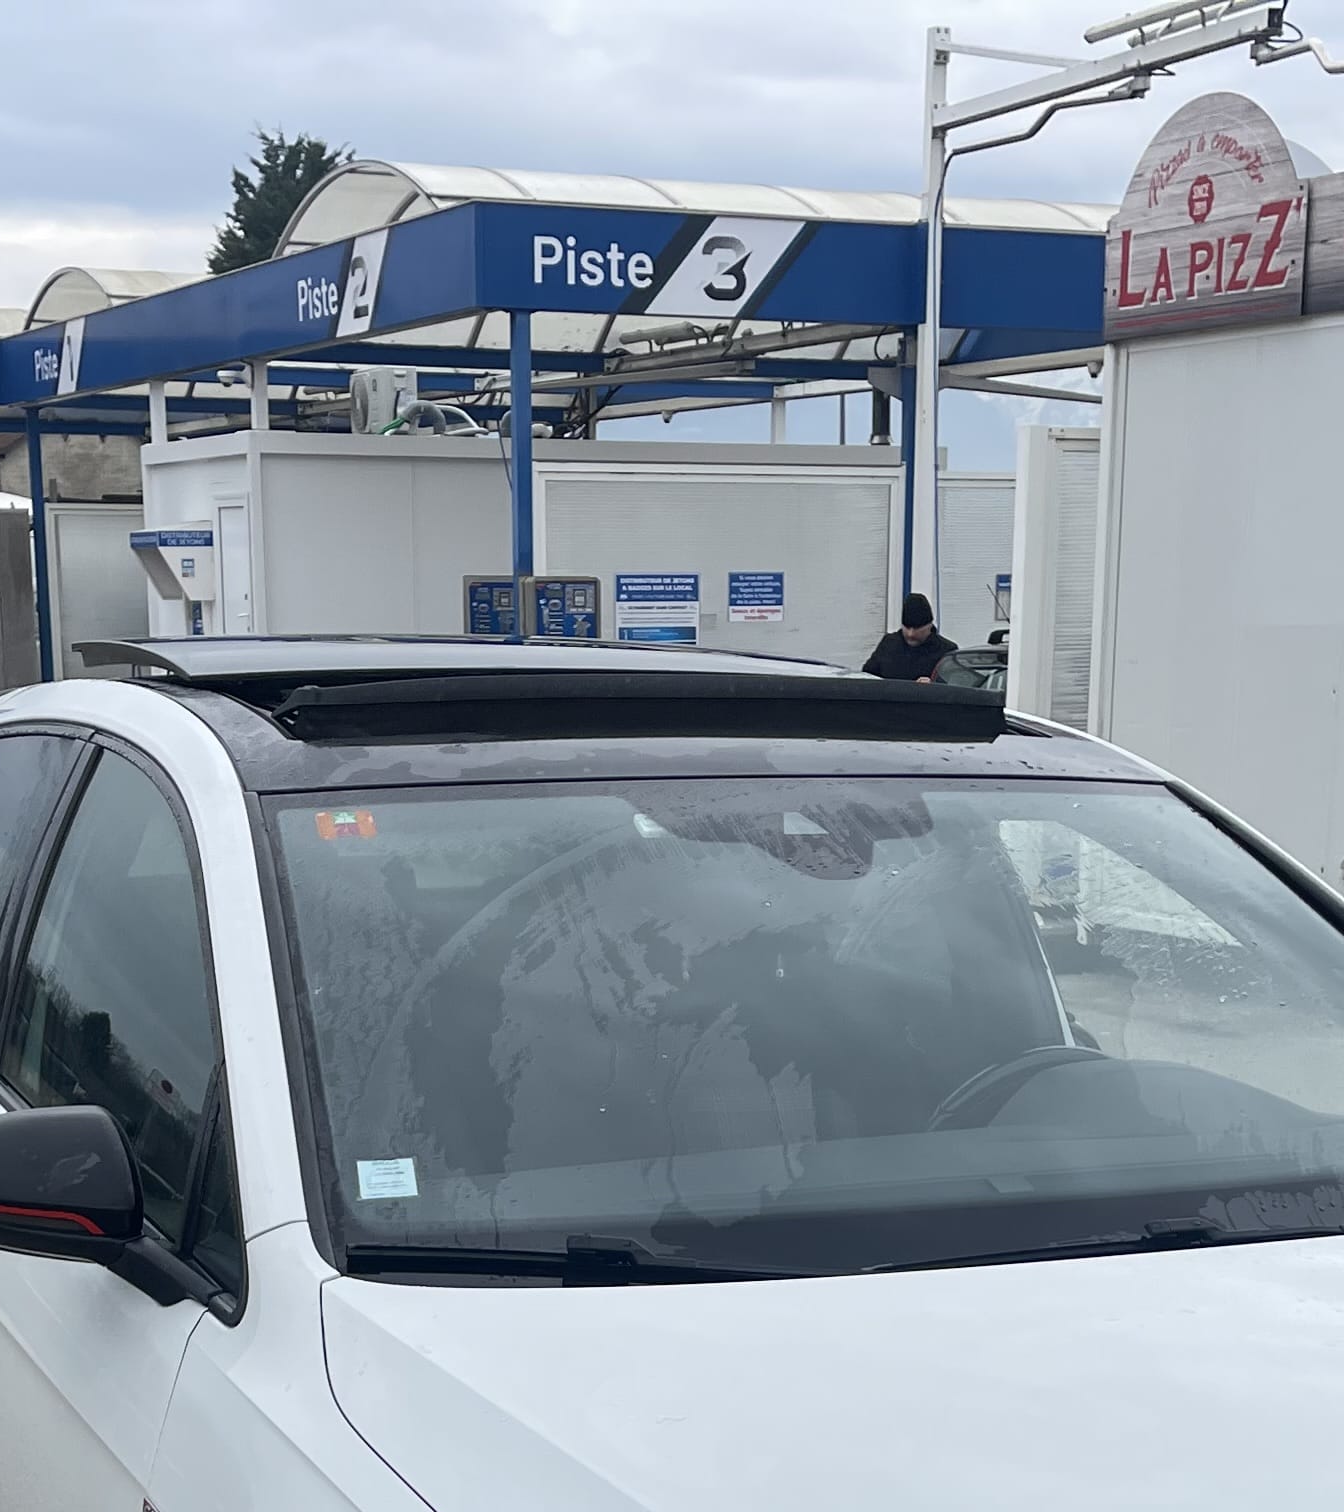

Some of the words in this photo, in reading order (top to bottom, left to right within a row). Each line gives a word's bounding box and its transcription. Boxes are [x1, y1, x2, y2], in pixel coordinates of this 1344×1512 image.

[297, 276, 338, 322] Piste
[350, 256, 369, 319] 2
[533, 235, 655, 289] Piste
[702, 236, 753, 302] 3
[1117, 228, 1175, 309] LA
[34, 348, 58, 382] Piste
